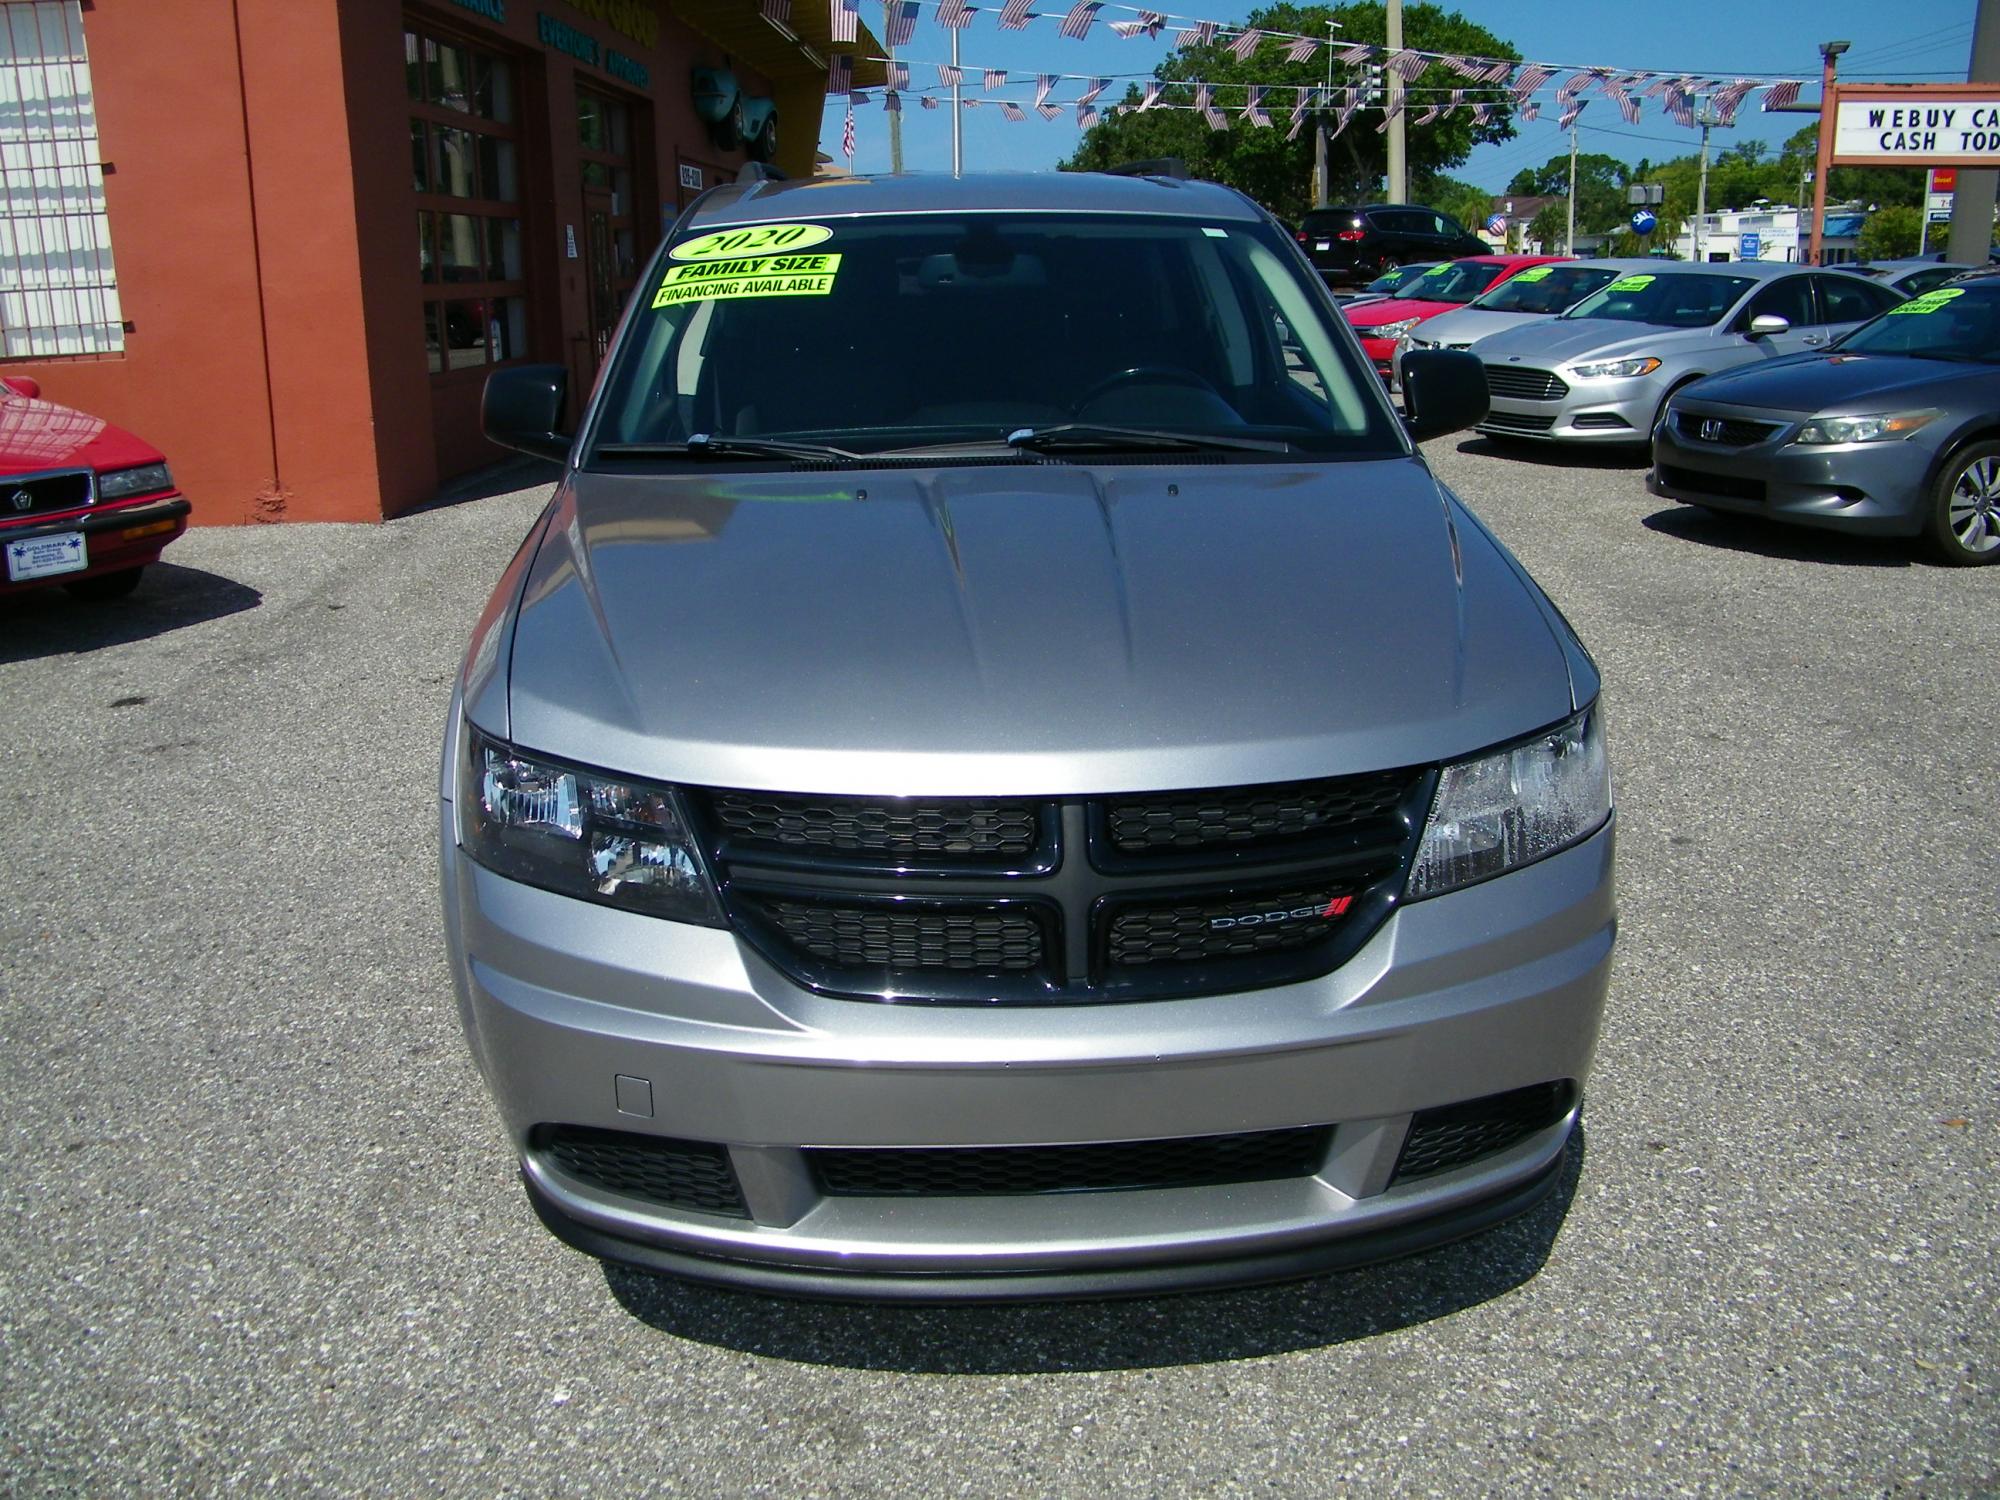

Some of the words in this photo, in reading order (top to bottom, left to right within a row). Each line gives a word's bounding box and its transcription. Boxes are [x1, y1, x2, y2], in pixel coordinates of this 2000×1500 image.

[1880, 132, 1936, 150] CASH
[690, 227, 806, 257] 2020
[676, 259, 767, 281] FAMILY
[770, 256, 829, 272] SIZE
[658, 282, 739, 303] FINANCING
[743, 278, 828, 293] AVAILABLE
[1211, 903, 1334, 928] DODGE
